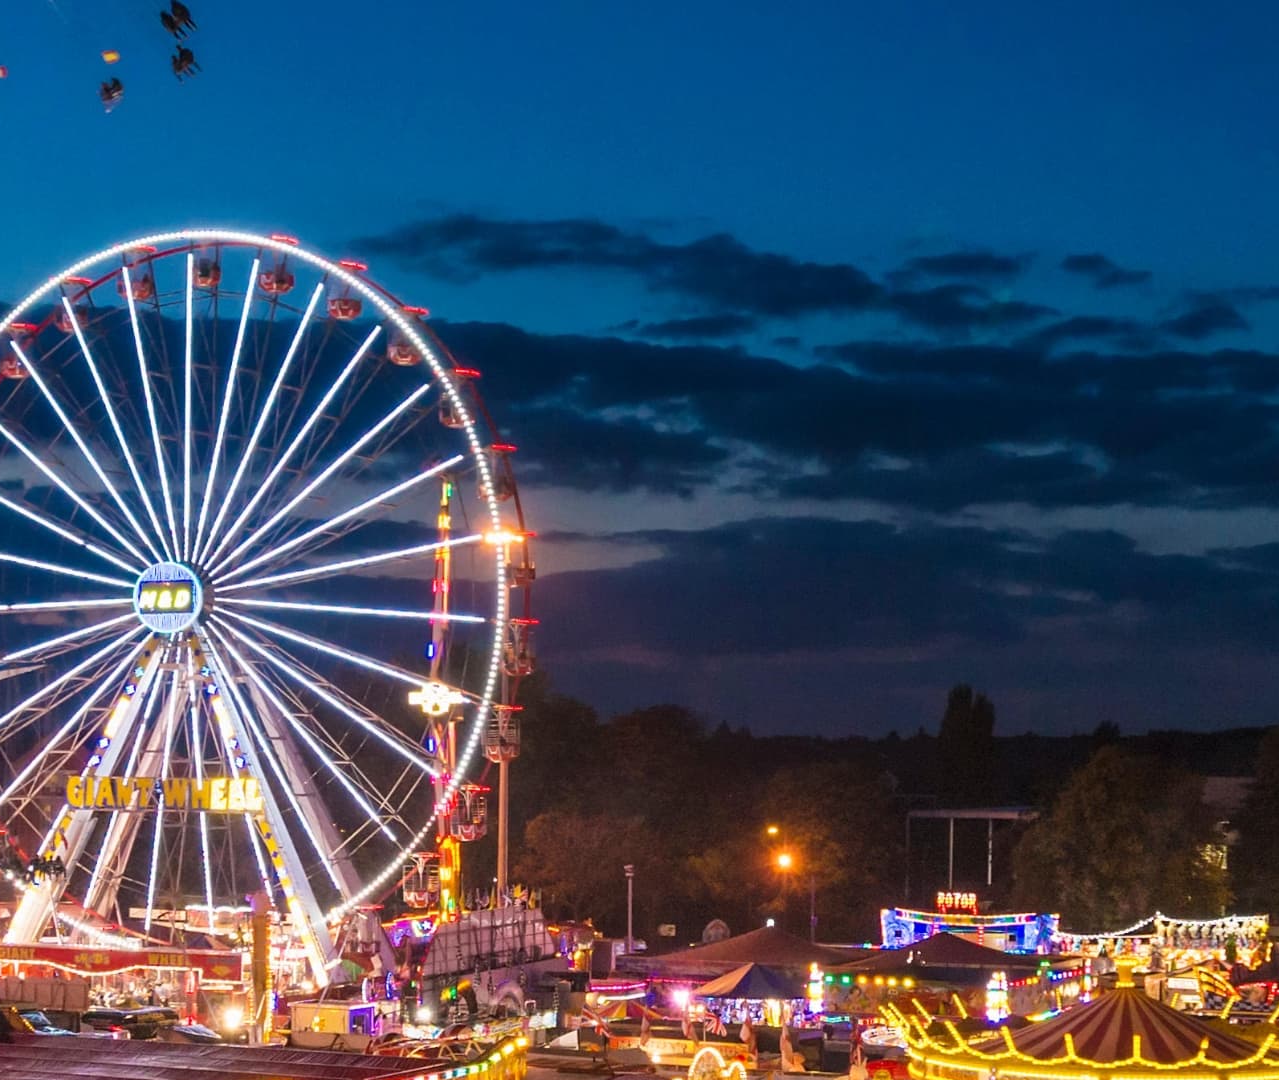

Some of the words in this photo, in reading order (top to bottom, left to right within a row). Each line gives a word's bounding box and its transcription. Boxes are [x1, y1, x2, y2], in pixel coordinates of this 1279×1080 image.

[66, 775, 153, 808] GIANT
[163, 776, 263, 811] WHEEL
[937, 891, 977, 909] ROTOR
[147, 953, 192, 966] WHEEL
